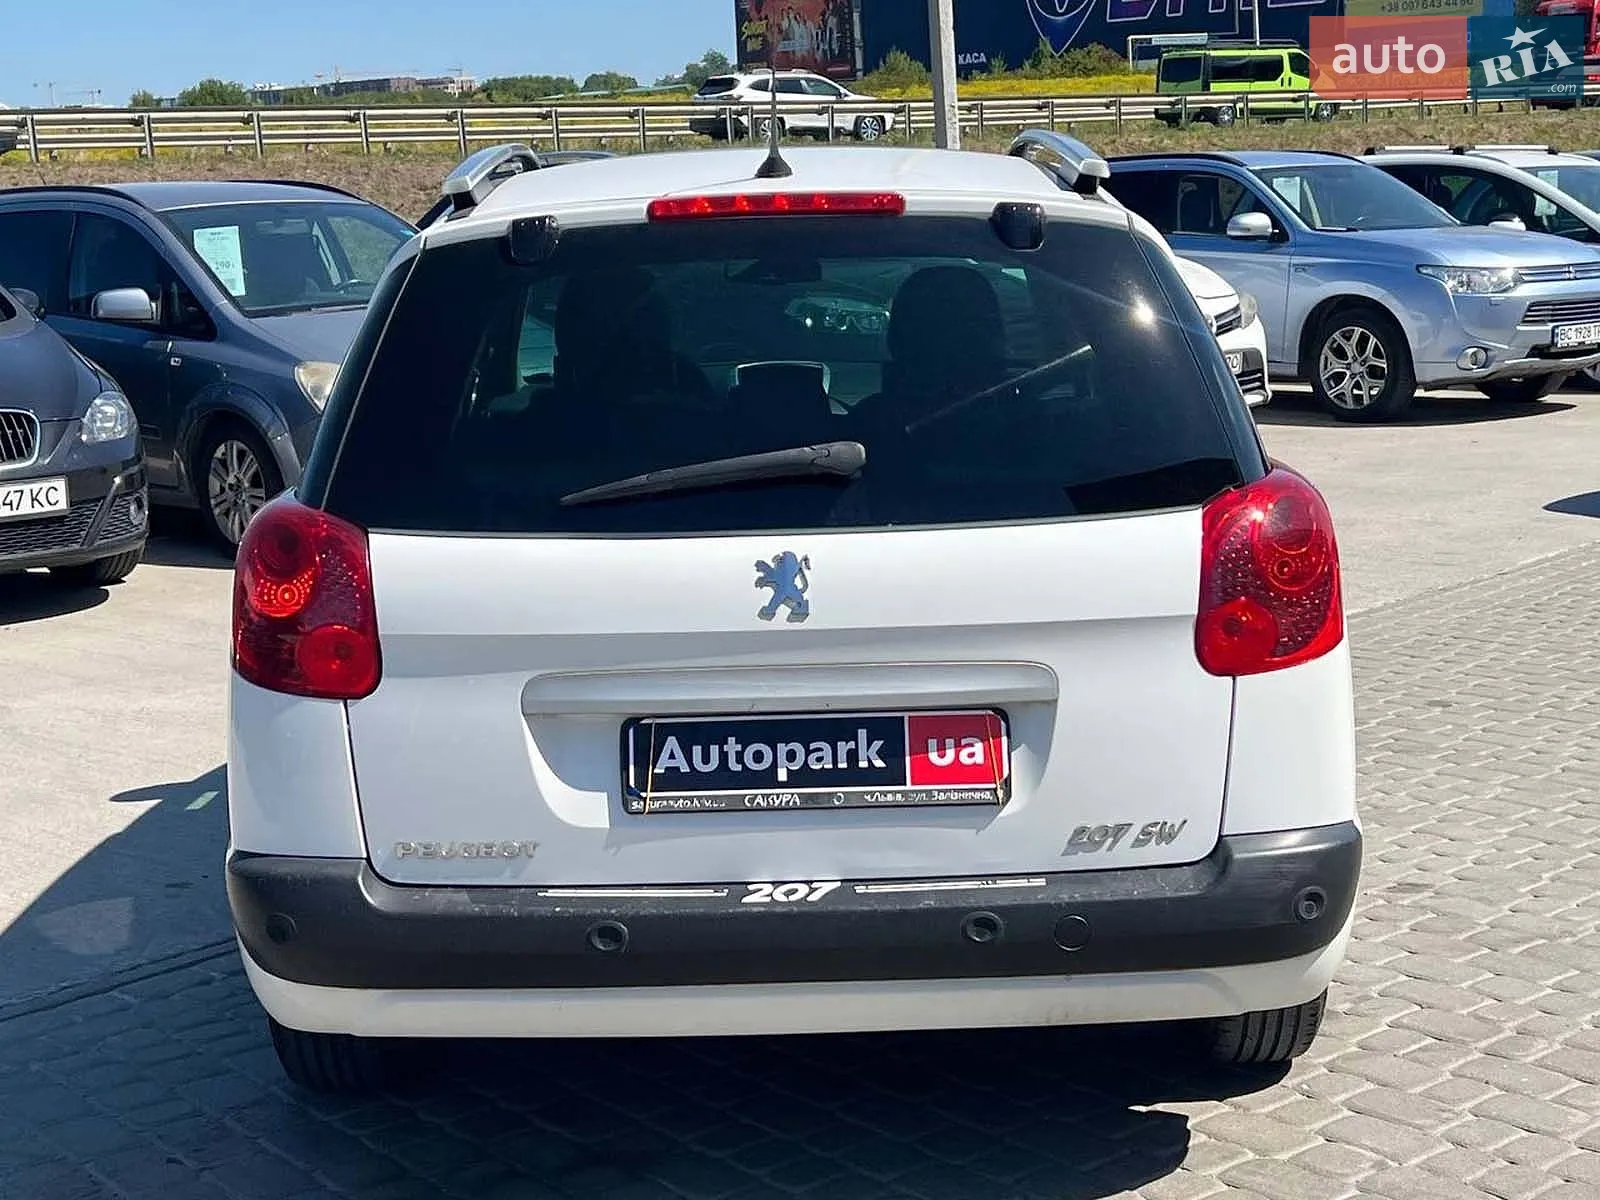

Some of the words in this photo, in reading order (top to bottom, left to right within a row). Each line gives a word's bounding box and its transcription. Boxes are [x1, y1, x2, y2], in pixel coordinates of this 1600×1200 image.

[30, 486, 59, 509] KC
[653, 728, 888, 782] Autopark
[927, 735, 985, 768] ua
[1130, 818, 1188, 849] SW
[394, 839, 539, 860] PEUGEOT
[741, 881, 842, 904] 207
